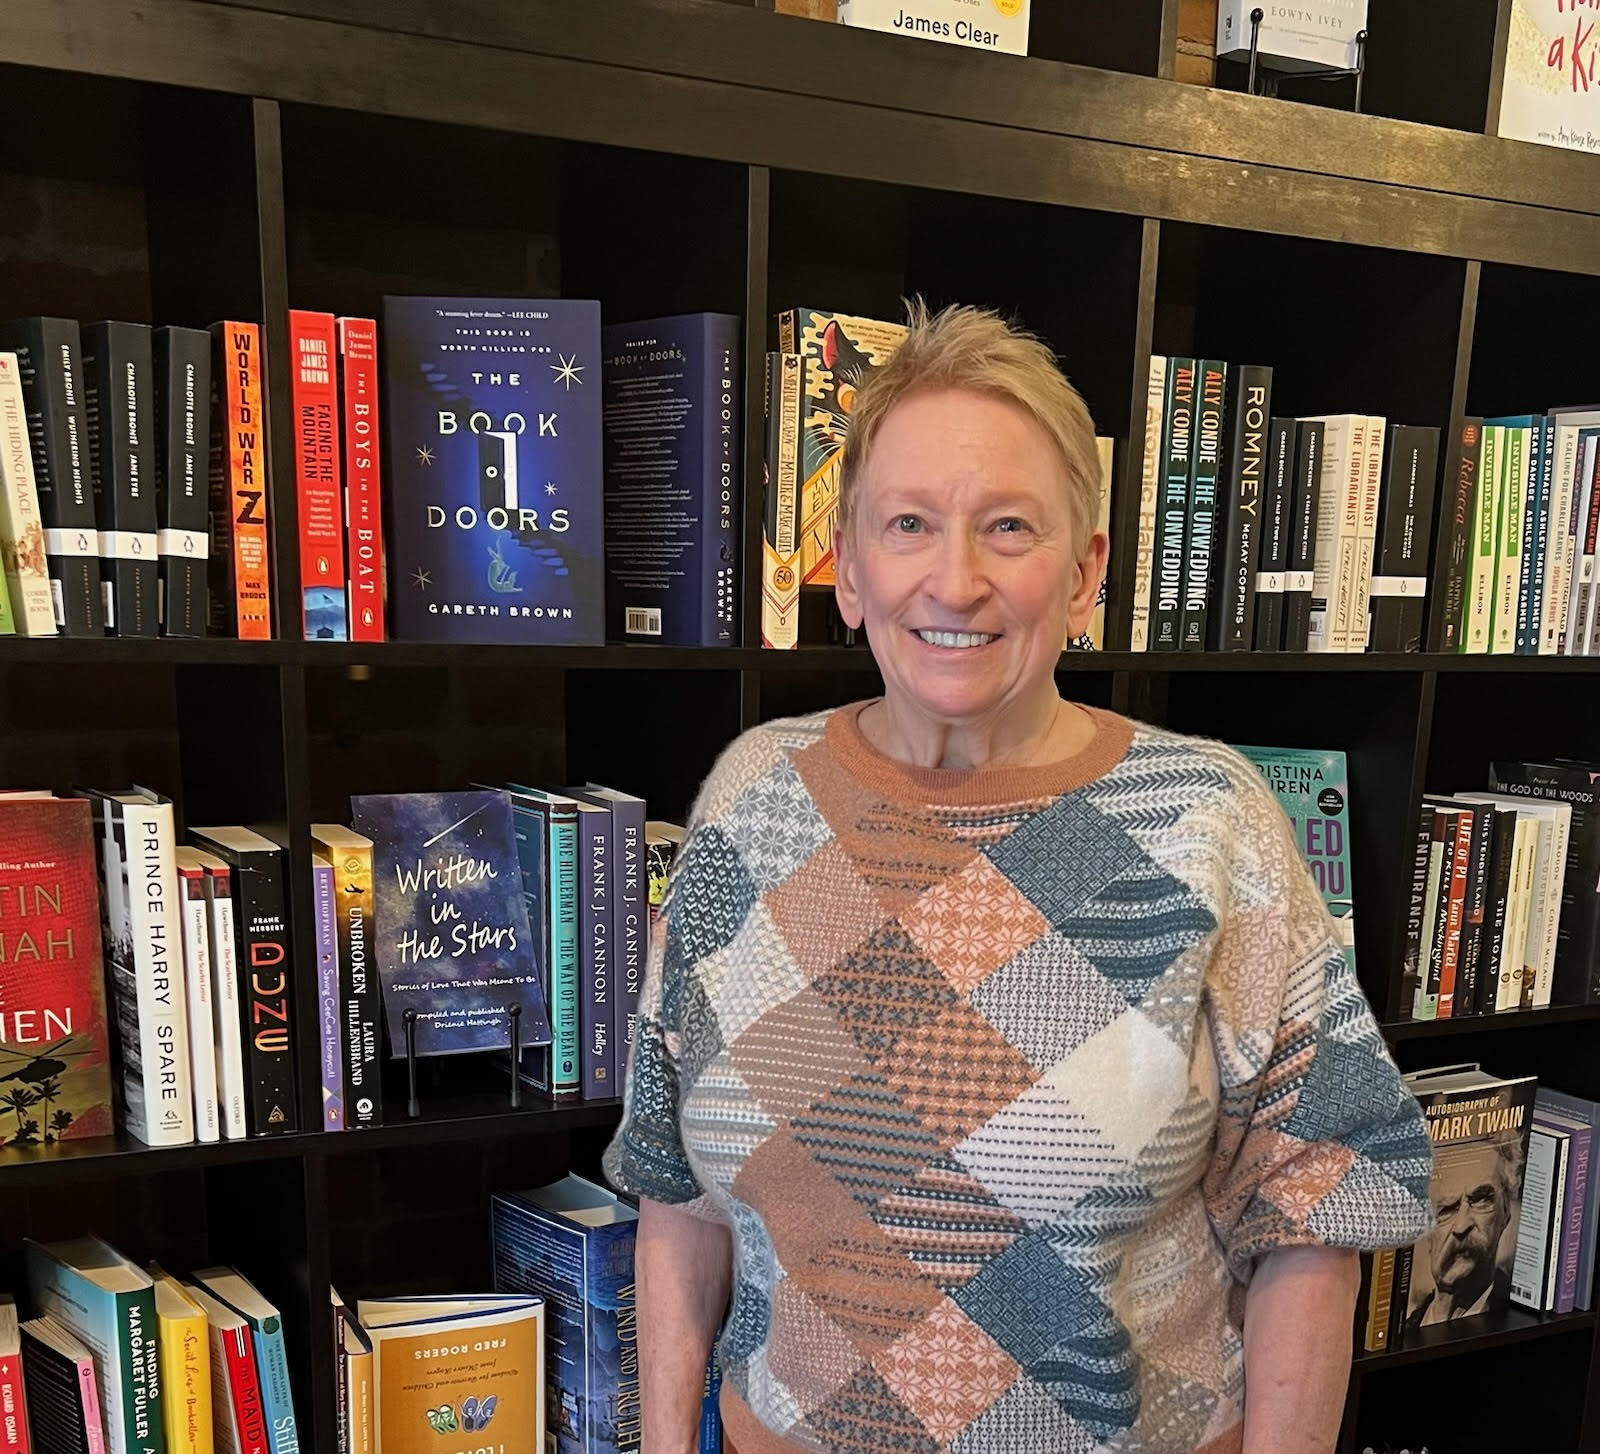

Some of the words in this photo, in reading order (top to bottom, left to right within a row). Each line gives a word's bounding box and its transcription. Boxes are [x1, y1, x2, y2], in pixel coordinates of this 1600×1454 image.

[893, 9, 949, 36] James
[955, 21, 999, 46] Clear
[1271, 7, 1312, 21] EOWYN
[1319, 14, 1343, 28] IVEY
[1547, 36, 1564, 71] a
[1571, 16, 1600, 92] Ki
[300, 338, 328, 354] DANIEL
[348, 331, 373, 340] Daniel
[349, 341, 372, 350] James
[61, 344, 71, 370] EMILY
[301, 354, 328, 368] JAMES
[349, 350, 373, 360] Brown
[233, 333, 251, 424] WORLD
[300, 368, 329, 384] BROWN
[357, 373, 366, 394] THE
[472, 373, 520, 386] THE
[1175, 368, 1192, 403] ALLY
[1204, 370, 1222, 405] ALLY
[4, 397, 20, 423] THE
[318, 404, 332, 450] FACING
[438, 411, 558, 437] BOOK
[8, 425, 26, 474] HIDING
[68, 415, 81, 467] WUTHERING
[302, 406, 317, 480] MOUNTAIN
[354, 403, 371, 469] BOYS
[1170, 409, 1191, 462] CONDIE
[1199, 410, 1220, 464] CONDIE
[1240, 386, 1265, 517] ROMNEY
[1531, 427, 1540, 455] DEAR
[1545, 427, 1554, 455] DEAR
[238, 432, 256, 485] WAR
[320, 452, 333, 483] THE
[1141, 405, 1161, 502] Atomic
[1563, 441, 1572, 475] CALLING
[72, 468, 84, 505] HEIGHTS
[360, 478, 368, 491] IN
[1167, 474, 1187, 504] THE
[1195, 475, 1216, 505] THE
[1484, 439, 1494, 508] INVISIBLE
[1528, 460, 1537, 501] DAMAGE
[1542, 460, 1551, 501] DAMAGE
[1561, 478, 1570, 493] FOR
[14, 476, 32, 515] PLACE
[236, 490, 265, 524] Z
[1456, 457, 1474, 525] Rebecca
[361, 499, 369, 520] THE
[427, 505, 571, 532] DOORS
[1558, 495, 1568, 529] CHARLIE
[1239, 523, 1251, 559] McKAY
[1483, 511, 1492, 543] MAN
[1525, 510, 1533, 549] ASHLEY
[1539, 510, 1547, 549] ASHLEY
[357, 529, 374, 593] BOAT
[1134, 512, 1155, 594] Habits
[1159, 511, 1185, 611] UNWEDDING
[1186, 511, 1213, 611] UNWEDDING
[1555, 531, 1564, 561] BARNES
[776, 568, 792, 584] 50
[1522, 553, 1530, 584] MARIE
[1535, 553, 1544, 584] MARIE
[1551, 566, 1560, 595] JOSHUA
[428, 604, 500, 616] GARETH
[510, 606, 573, 619] BROWN
[1235, 567, 1248, 624] COPPINS
[1477, 575, 1485, 615] ELLISON
[1519, 589, 1528, 631] FARMER
[1532, 589, 1541, 631] FARMER
[1256, 764, 1325, 781] RISTINA
[1496, 782, 1507, 792] THE
[1509, 783, 1531, 795] GOD
[1533, 786, 1543, 795] OF
[1545, 788, 1556, 798] THE
[1559, 789, 1594, 803] WOODS
[1458, 817, 1470, 844] LIFE
[1482, 812, 1491, 837] THIS
[559, 827, 574, 857] ANNE
[625, 827, 637, 889] FRANK
[1447, 840, 1454, 855] TO
[1457, 848, 1467, 862] OF
[24, 861, 56, 869] Author
[142, 822, 164, 913] PRINCE
[395, 854, 498, 895] Written
[593, 835, 604, 898] FRANK
[1443, 860, 1452, 891] KILL
[1455, 865, 1467, 879] PI
[1477, 841, 1487, 885] TENDER
[320, 873, 329, 897] BETH
[560, 860, 574, 924] HILLERMAN
[623, 896, 637, 908] J.
[1408, 832, 1430, 940] ENDURANCE
[1474, 887, 1483, 917] LAND
[1538, 860, 1550, 913] SOJOURN
[253, 916, 280, 924] FRANK
[321, 900, 331, 945] HOFFMAN
[430, 892, 461, 925] in
[591, 905, 605, 917] J.
[1450, 897, 1463, 926] Yann
[1495, 897, 1505, 927] THE
[249, 924, 285, 933] HERBERT
[396, 930, 443, 964] the
[450, 921, 517, 959] Stars
[1432, 908, 1448, 981] Mockingbird
[560, 938, 574, 956] THE
[594, 923, 606, 1004] CANNON
[626, 915, 638, 994] CANNON
[1445, 929, 1460, 968] Martel
[1490, 934, 1501, 975] ROAD
[149, 925, 172, 1006] HARRY
[321, 969, 334, 996] Saving
[560, 957, 574, 985] WAY
[348, 907, 366, 995] UNBROKEN
[362, 1022, 374, 1063] LAURA
[392, 983, 420, 992] Stories
[421, 982, 429, 990] of
[451, 980, 470, 988] That
[489, 978, 514, 986] Meant
[561, 988, 574, 1003] OF
[0, 1007, 72, 1043] EN
[323, 998, 335, 1035] CeeCee
[561, 1005, 575, 1027] THE
[348, 1000, 364, 1086] HILLENBRAND
[561, 1030, 575, 1058] BEAR
[592, 1023, 606, 1057] Holley
[156, 1025, 178, 1101] SPARE
[233, 1096, 241, 1125] OXFORD
[1425, 1097, 1488, 1117] AUTOBIOGRAPHY
[1489, 1096, 1500, 1107] OF
[1427, 1113, 1471, 1142] MARK
[1477, 1105, 1525, 1135] TWAIN
[1576, 1149, 1588, 1190] SPELLS
[1570, 1205, 1583, 1235] LOST
[1564, 1239, 1579, 1284] THINGS
[616, 1283, 636, 1341] WIND
[128, 1306, 144, 1384] MARGARET
[414, 1344, 469, 1360] ROGERS
[474, 1338, 506, 1352] FRED
[619, 1346, 636, 1375] AND
[146, 1340, 159, 1399] FINDING
[241, 1365, 250, 1384] THE
[134, 1387, 149, 1440] FULLER
[240, 1387, 261, 1441] MAID
[616, 1377, 640, 1448] TRUTH
[273, 1416, 300, 1454] Stiff
